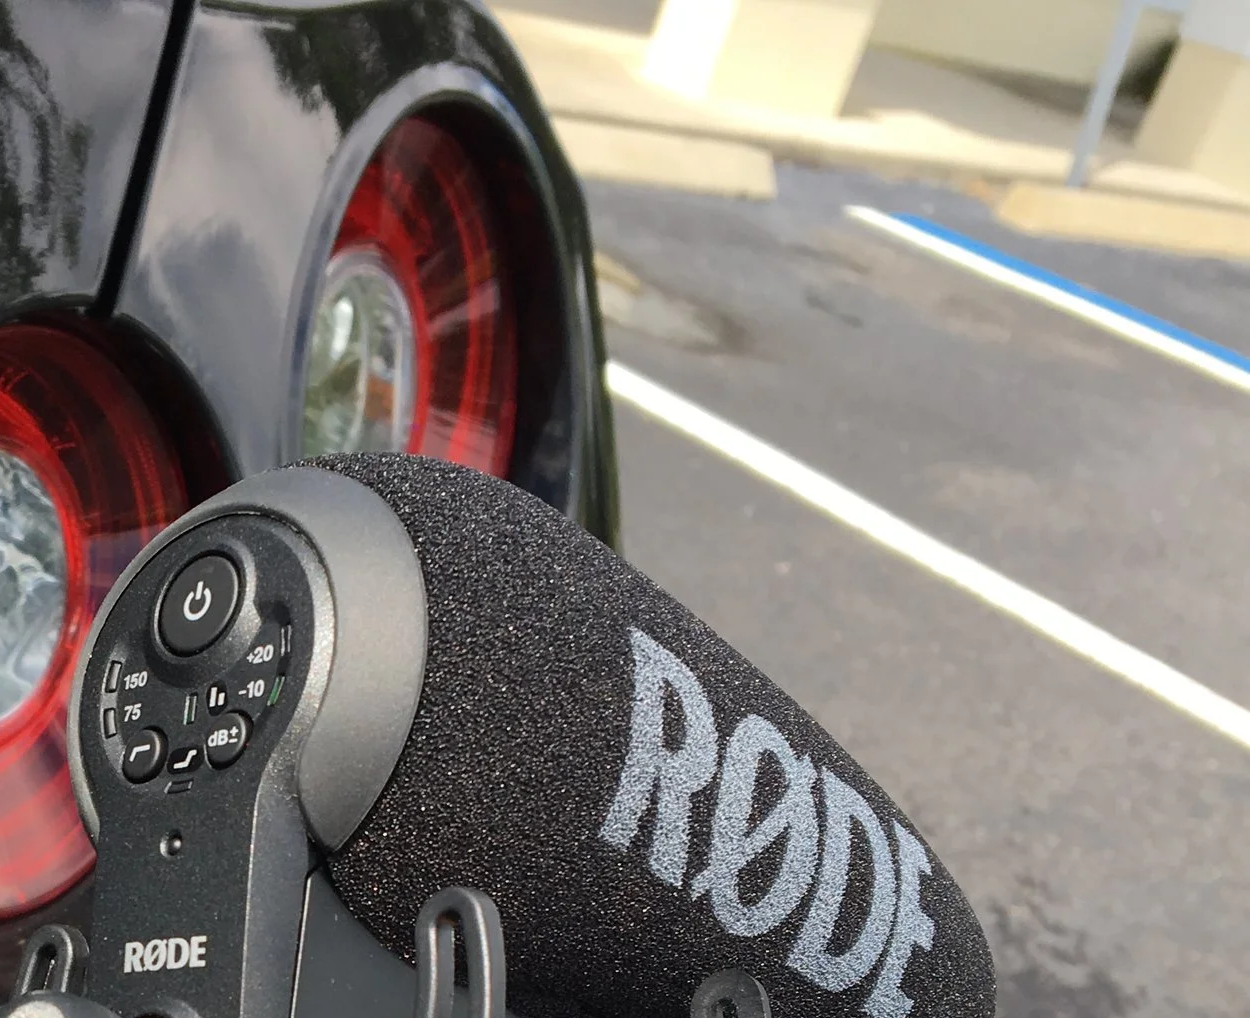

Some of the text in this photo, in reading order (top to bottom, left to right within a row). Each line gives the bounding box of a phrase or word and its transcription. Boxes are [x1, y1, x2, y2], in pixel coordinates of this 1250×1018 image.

[246, 644, 274, 665] +20
[123, 671, 148, 690] 150
[238, 679, 265, 698] -10
[124, 703, 141, 722] 75
[123, 935, 207, 974] RØDE
